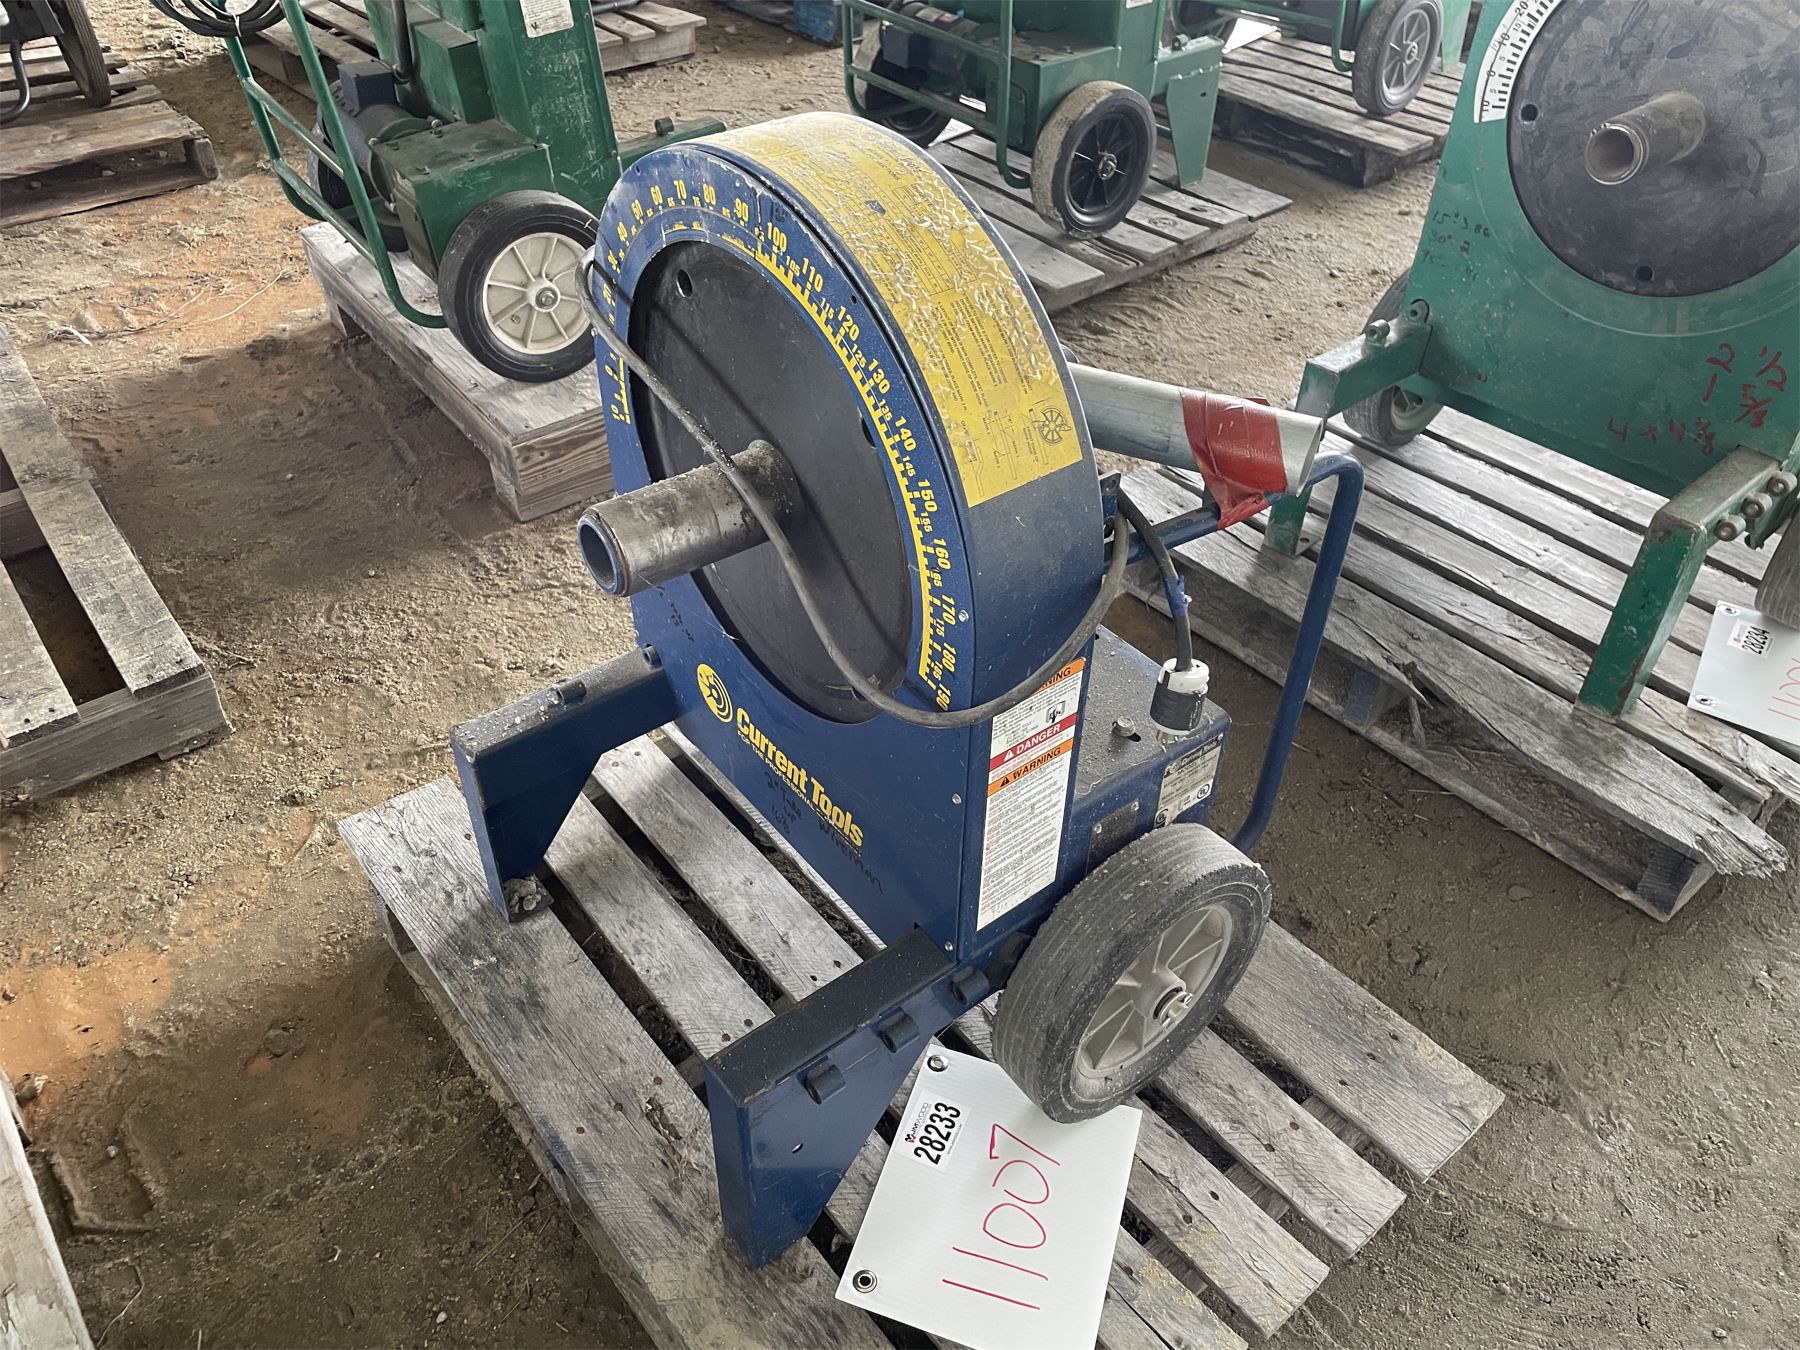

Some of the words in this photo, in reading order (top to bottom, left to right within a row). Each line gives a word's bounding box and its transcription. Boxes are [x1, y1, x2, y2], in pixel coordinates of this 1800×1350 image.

[1515, 0, 1529, 17] 20
[1499, 32, 1510, 47] 10
[1482, 100, 1490, 112] 10
[673, 179, 687, 199] 70
[702, 183, 716, 205] 80
[735, 197, 749, 222] 90
[767, 221, 787, 253] 100
[786, 255, 800, 276] 105
[802, 257, 823, 293] 110
[821, 297, 834, 319] 115
[838, 305, 860, 341] 120
[851, 343, 867, 368] 125
[1706, 343, 1736, 374] 2
[868, 358, 890, 394] 130
[1703, 373, 1718, 402] 1
[879, 399, 893, 421] 135
[895, 416, 916, 451] 140
[1607, 417, 1630, 441] 4
[902, 455, 916, 477] 145
[917, 478, 938, 512] 150
[921, 511, 933, 532] 155
[933, 538, 951, 569] 160
[942, 595, 956, 625] 170
[936, 618, 945, 637] 175
[1742, 626, 1771, 655] 28234
[942, 642, 957, 672] 180
[936, 683, 951, 712] 190
[1016, 723, 1061, 755] DANGER
[736, 707, 808, 793] Current
[810, 775, 863, 847] Tools
[1012, 747, 1061, 780] WARNING
[913, 1102, 961, 1165] 28233
[942, 1123, 1061, 1310] 11007
